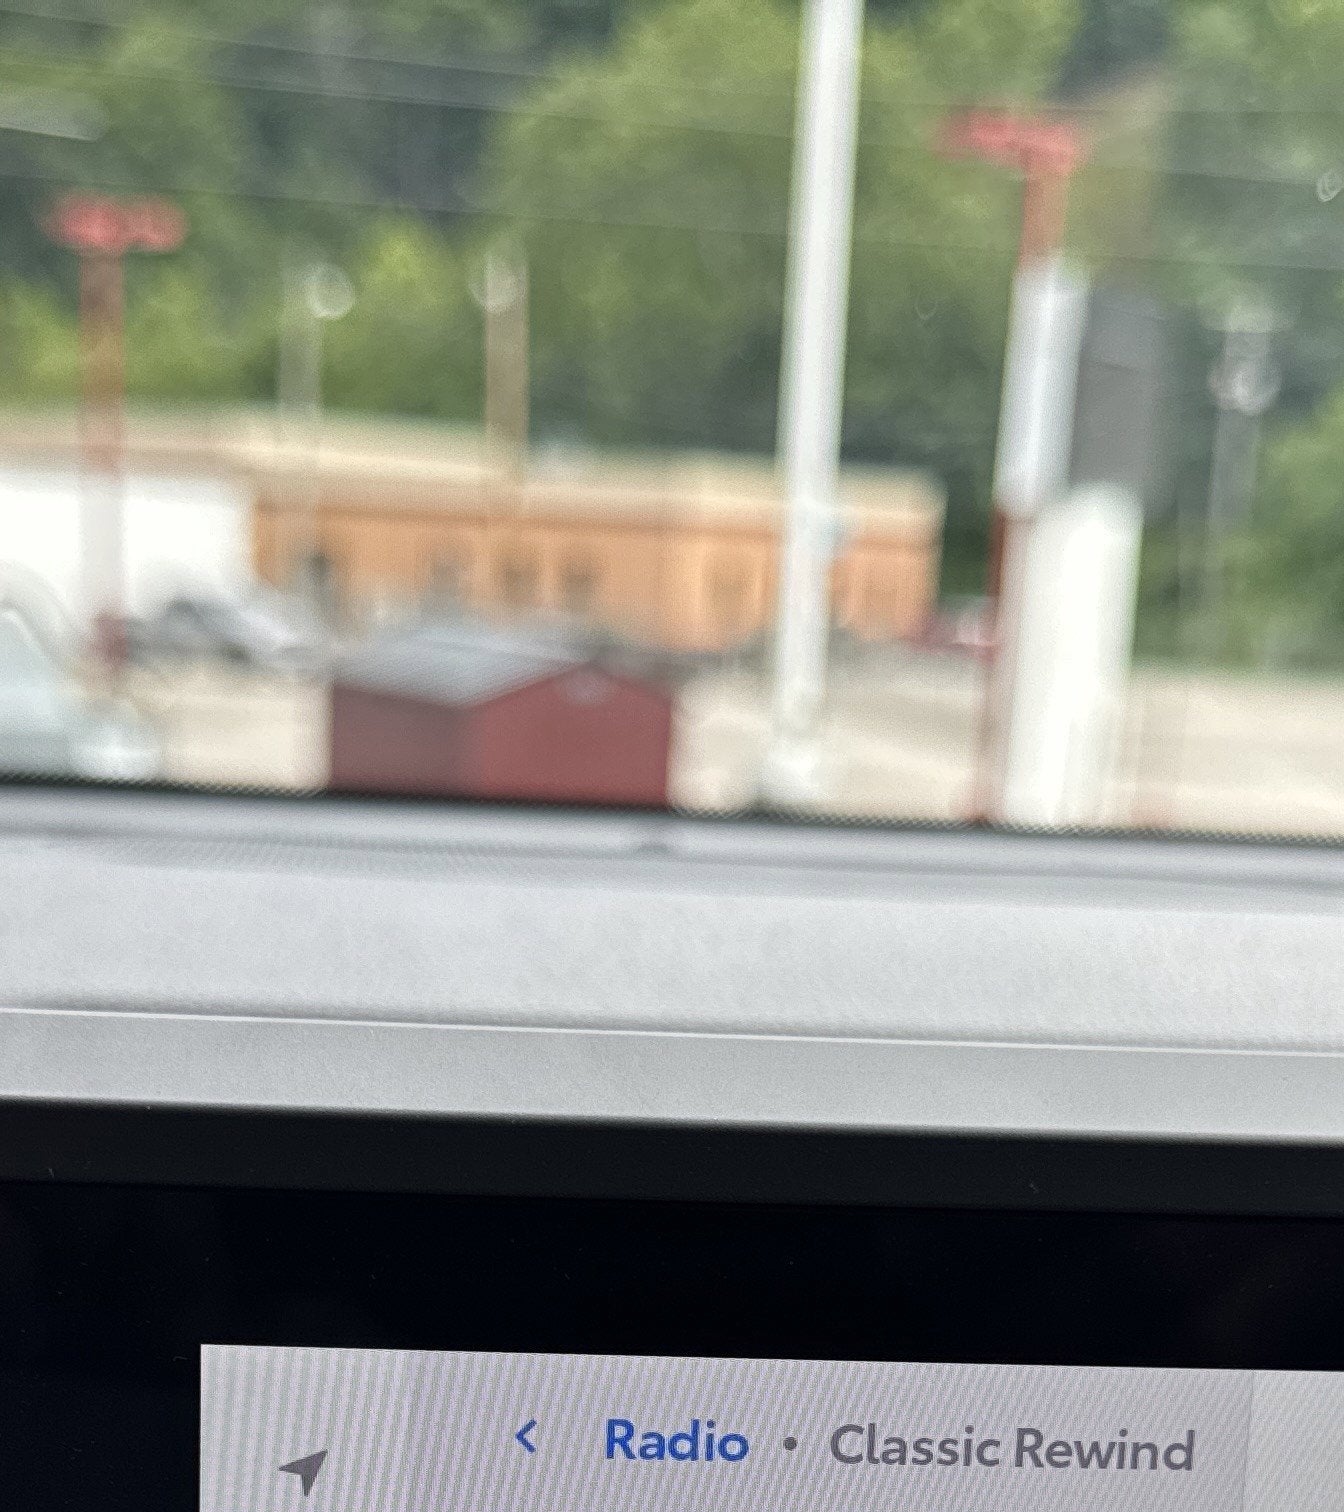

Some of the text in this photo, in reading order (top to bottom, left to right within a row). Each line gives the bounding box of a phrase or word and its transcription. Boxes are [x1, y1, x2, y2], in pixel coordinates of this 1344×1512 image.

[605, 1419, 750, 1462] Radio
[830, 1423, 1196, 1471] Classic Rewind
